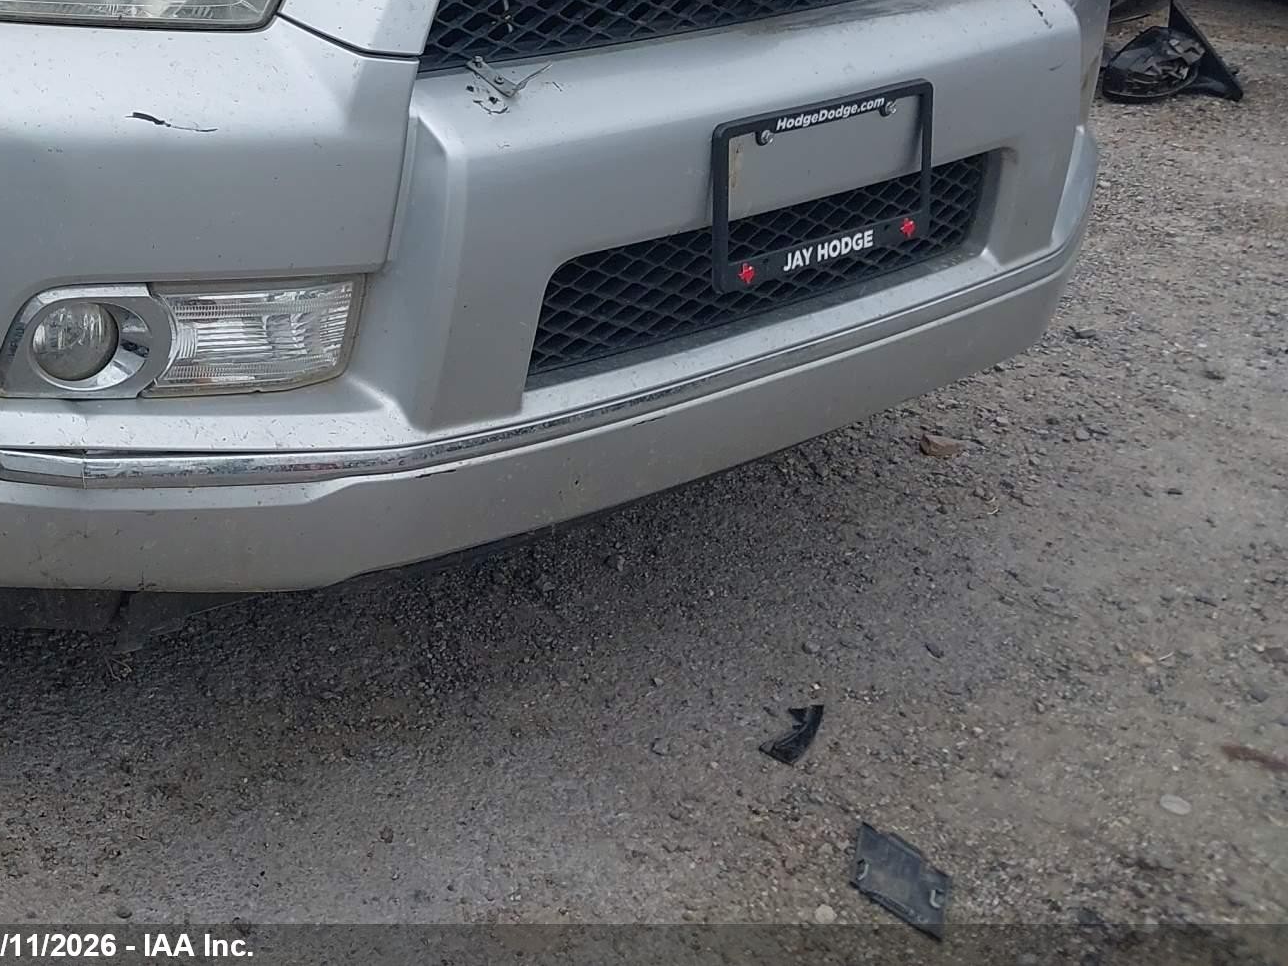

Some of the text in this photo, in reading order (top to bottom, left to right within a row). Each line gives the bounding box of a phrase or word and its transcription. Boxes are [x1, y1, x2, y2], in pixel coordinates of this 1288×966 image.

[775, 97, 886, 132] HodgeDodge.com
[783, 229, 875, 273] JAY HODGE
